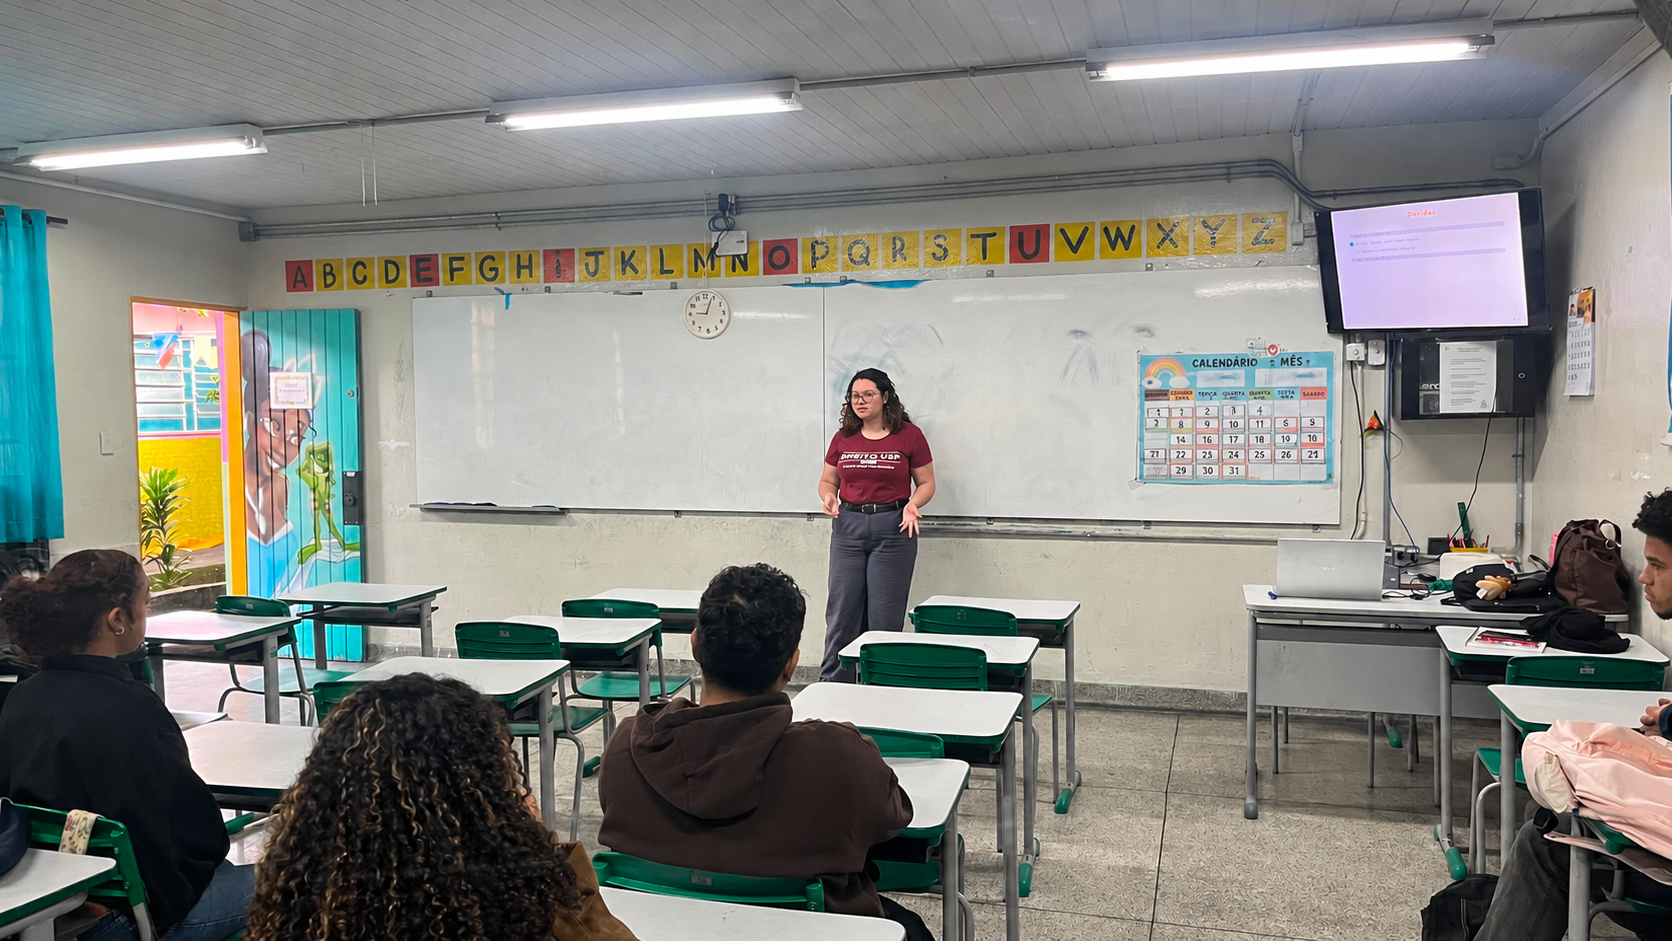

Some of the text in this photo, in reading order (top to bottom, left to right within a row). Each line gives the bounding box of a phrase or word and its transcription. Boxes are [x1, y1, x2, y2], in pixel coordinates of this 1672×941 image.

[292, 265, 308, 288] A
[322, 262, 337, 288] B
[352, 260, 368, 285] C
[384, 259, 400, 284] D
[415, 257, 432, 283] E
[448, 256, 465, 282] F
[478, 254, 499, 282] G
[516, 253, 533, 279] H
[584, 250, 604, 277] J
[620, 249, 639, 275] K
[659, 247, 674, 275] L
[694, 248, 715, 273] M
[767, 245, 790, 271] O
[810, 239, 830, 270] P
[847, 238, 870, 266] Q
[891, 236, 907, 263] R
[931, 233, 949, 262] S
[970, 231, 998, 261] T
[1017, 229, 1041, 260] U
[1059, 225, 1090, 254] V
[1102, 224, 1136, 251] W
[1156, 221, 1179, 249] X
[1201, 218, 1226, 248] Y
[1251, 217, 1275, 246] Z
[1192, 356, 1258, 368] CALENDÁRIO
[1280, 354, 1303, 367] MÊS
[1205, 407, 1210, 416] 2
[1256, 406, 1263, 416] 4
[1178, 420, 1184, 429] 8
[1204, 420, 1210, 429] 9
[1229, 420, 1239, 428] 10
[1256, 420, 1264, 428] 11
[1203, 436, 1212, 444] 16
[1229, 435, 1239, 444] 17
[1175, 451, 1186, 459] 22
[1228, 450, 1239, 459] 24
[1254, 450, 1265, 459] 25
[1281, 450, 1292, 459] 26
[1175, 466, 1239, 475] 29 30 31
